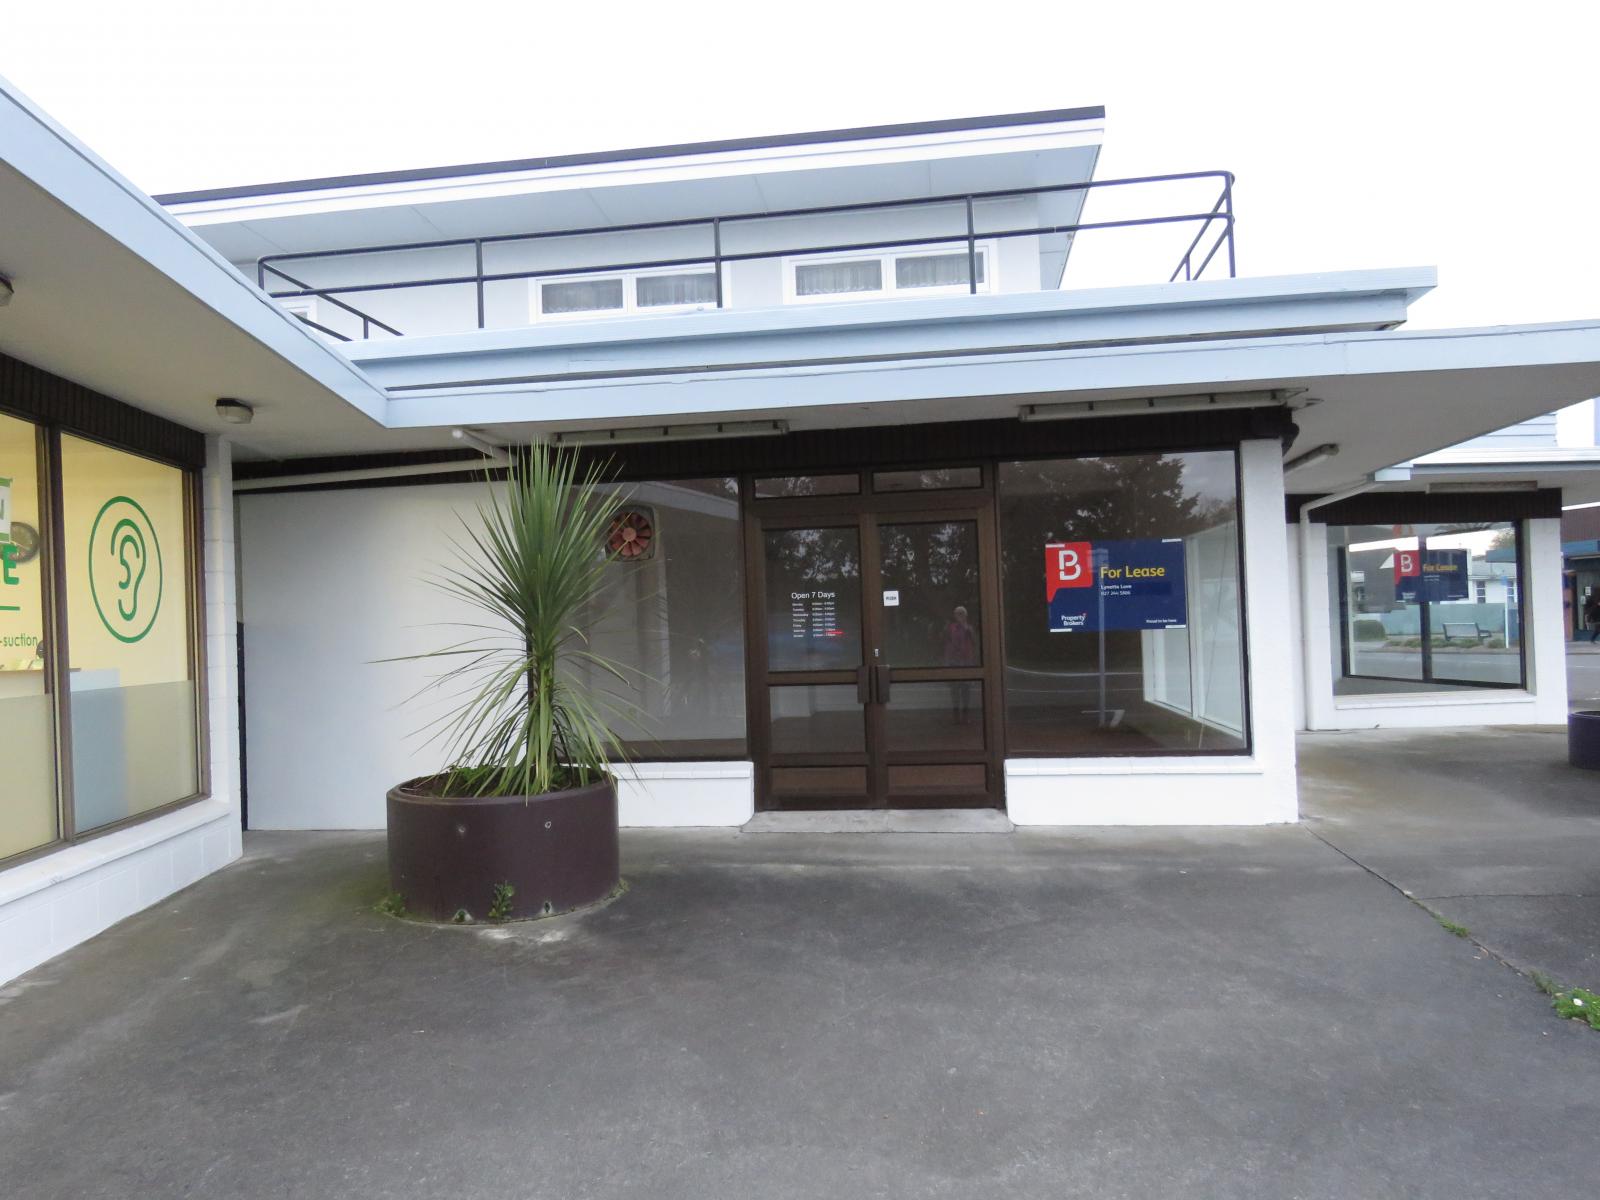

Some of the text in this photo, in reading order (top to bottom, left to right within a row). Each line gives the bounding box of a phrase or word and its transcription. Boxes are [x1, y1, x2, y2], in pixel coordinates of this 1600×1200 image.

[1058, 549, 1082, 581] B
[1400, 554, 1413, 573] B
[1100, 565, 1165, 579] For Lease
[791, 591, 836, 600] Open 7 Days
